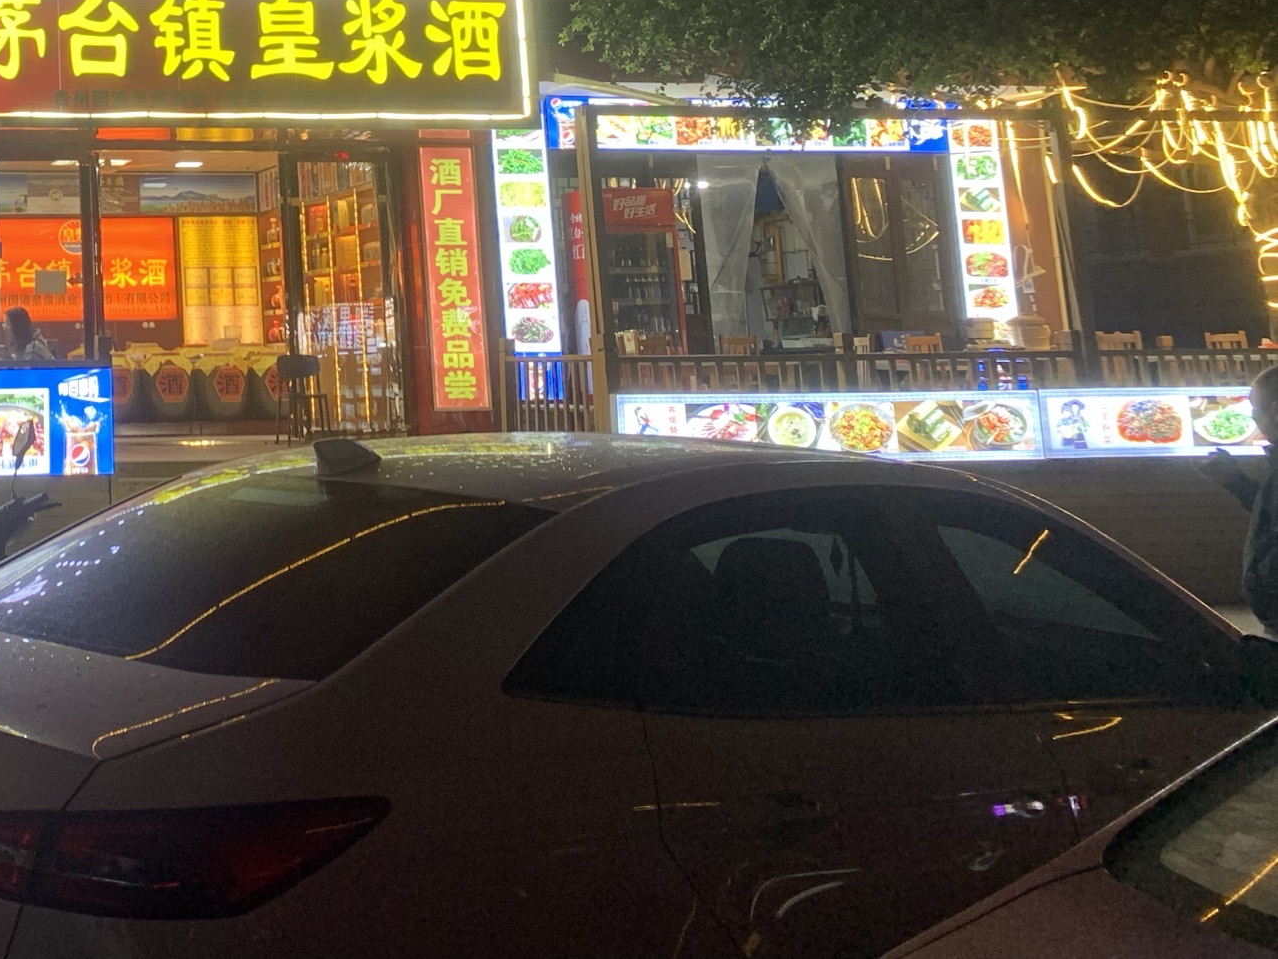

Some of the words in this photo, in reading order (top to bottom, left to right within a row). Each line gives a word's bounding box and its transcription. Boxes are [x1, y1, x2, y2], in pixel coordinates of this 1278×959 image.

[430, 158, 477, 400] 酒厂直销免费品尝
[159, 375, 183, 394] 酒
[215, 375, 239, 394] 酒
